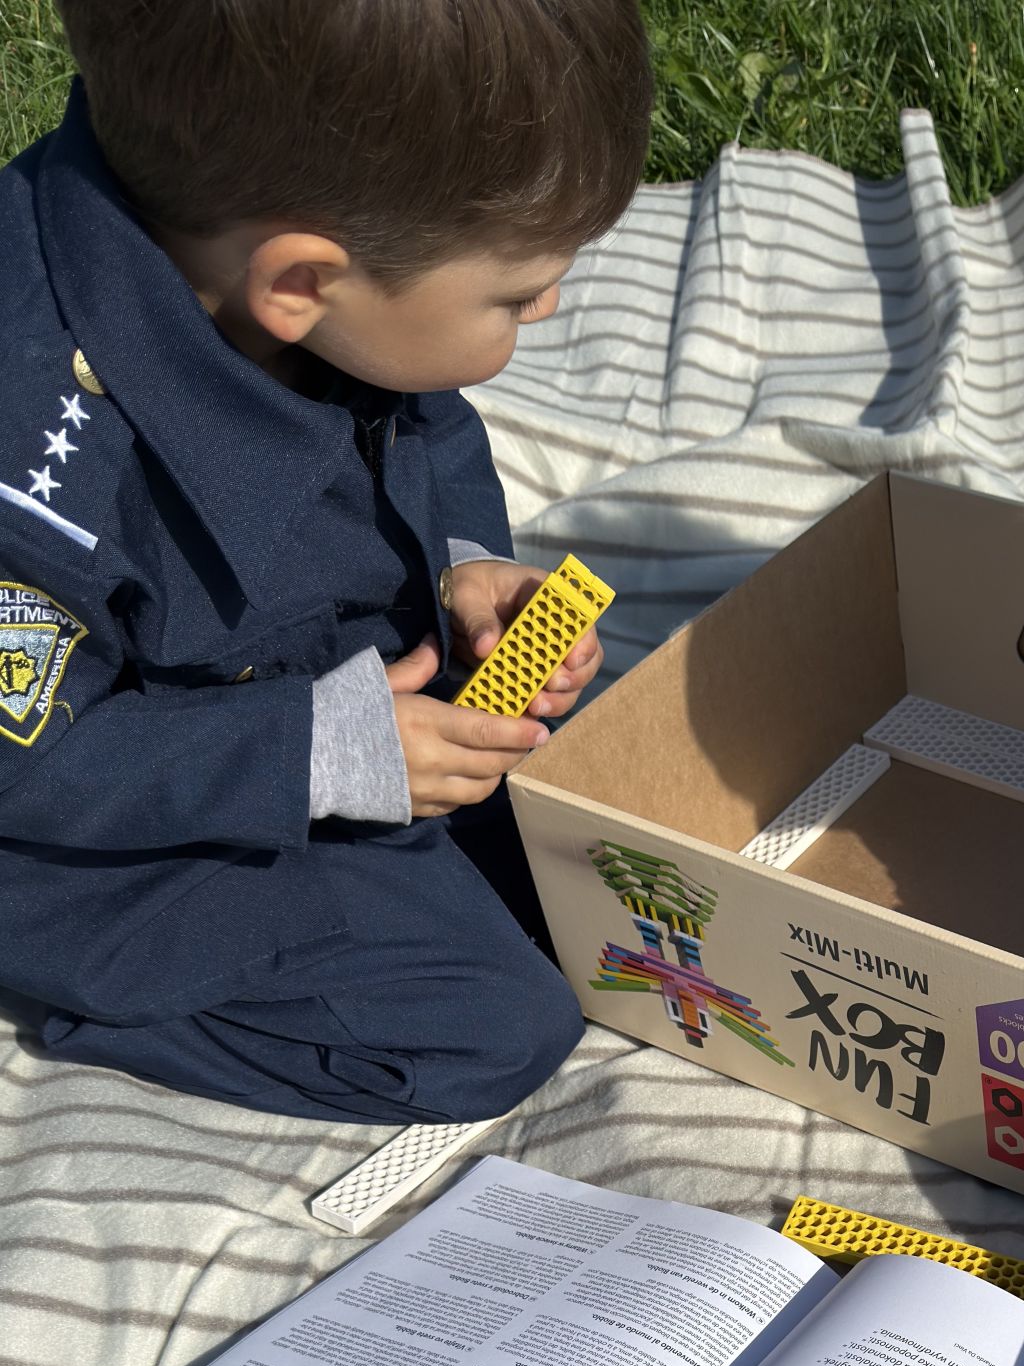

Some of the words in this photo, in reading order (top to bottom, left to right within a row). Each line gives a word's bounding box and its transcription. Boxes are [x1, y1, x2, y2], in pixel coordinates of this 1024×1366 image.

[0, 589, 50, 607] LICE
[35, 637, 71, 714] AMERICA
[786, 922, 929, 996] Multi-Mix
[784, 969, 946, 1077] BOX
[808, 1029, 932, 1126] FUN
[645, 1263, 670, 1274] Bioblo.
[669, 1270, 683, 1278] van
[681, 1275, 708, 1289] wereld
[726, 1296, 757, 1318] Welkom
[590, 1313, 616, 1325] Bioblo.
[624, 1325, 653, 1341] mundo
[953, 1342, 968, 1353] Vinci
